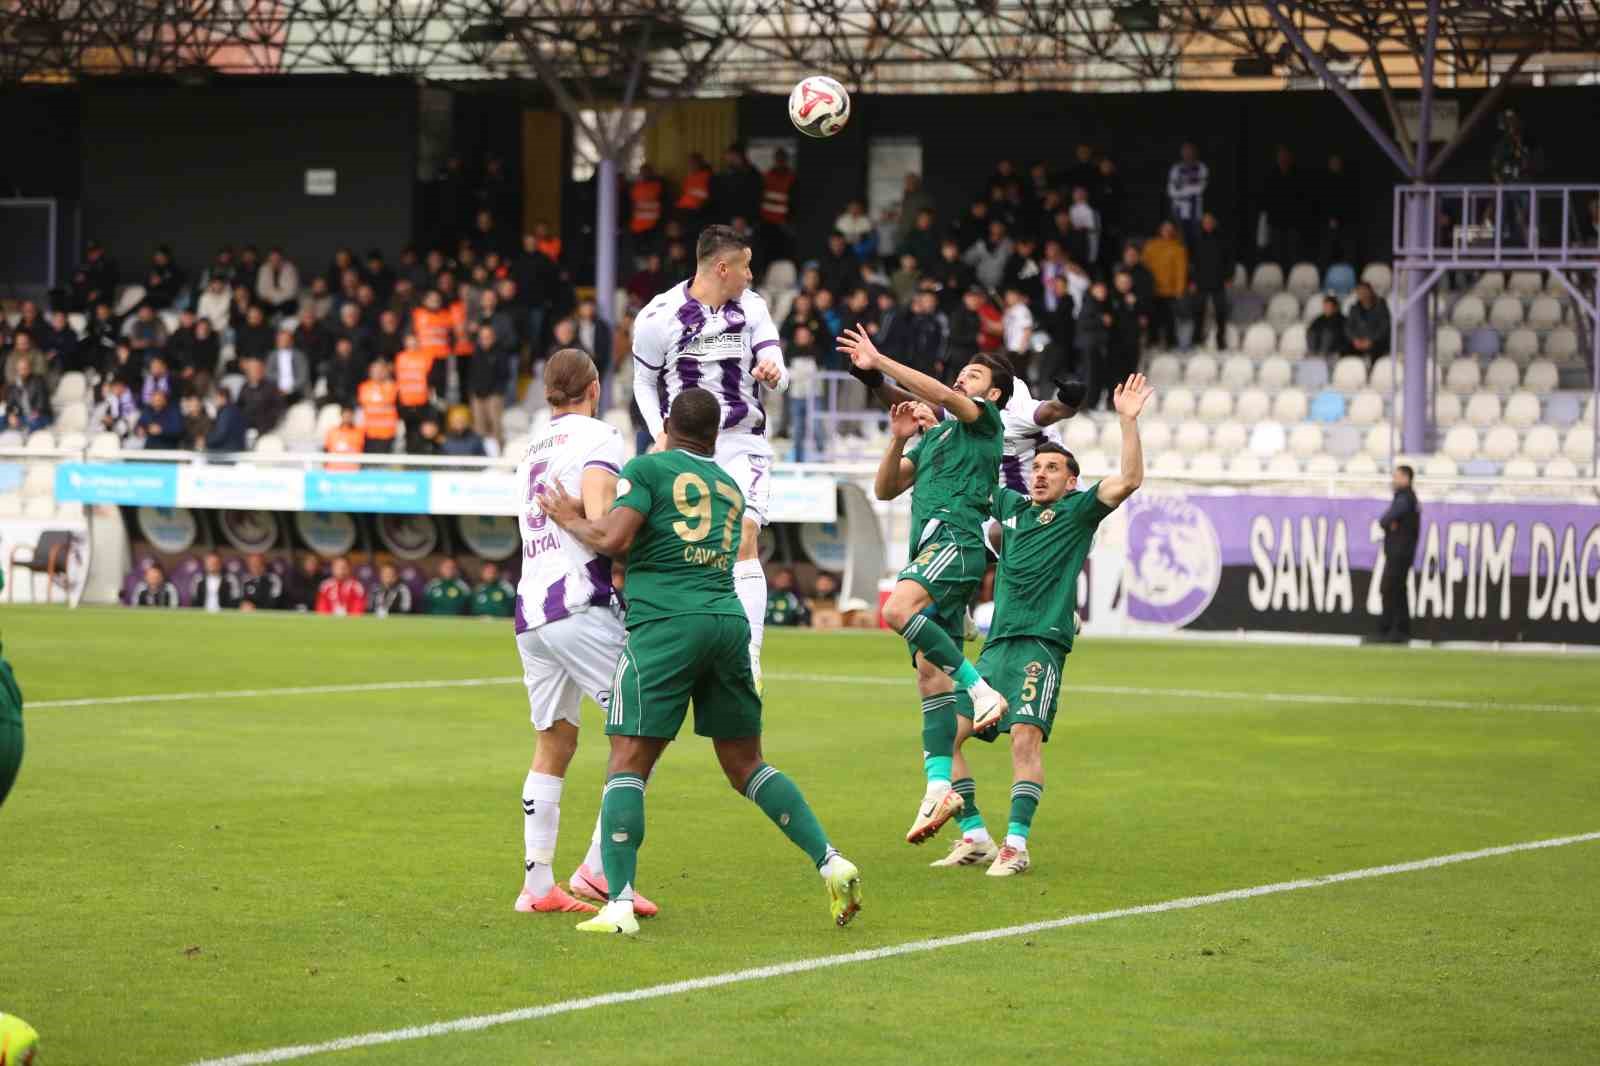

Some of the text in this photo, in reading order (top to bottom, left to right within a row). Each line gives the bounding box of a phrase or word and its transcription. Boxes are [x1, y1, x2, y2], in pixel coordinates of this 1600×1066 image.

[750, 467, 763, 489] 7
[672, 472, 744, 552] 97
[1248, 515, 1353, 614] SANA
[1366, 517, 1519, 621] ZAFIM
[1021, 676, 1039, 702] 5
